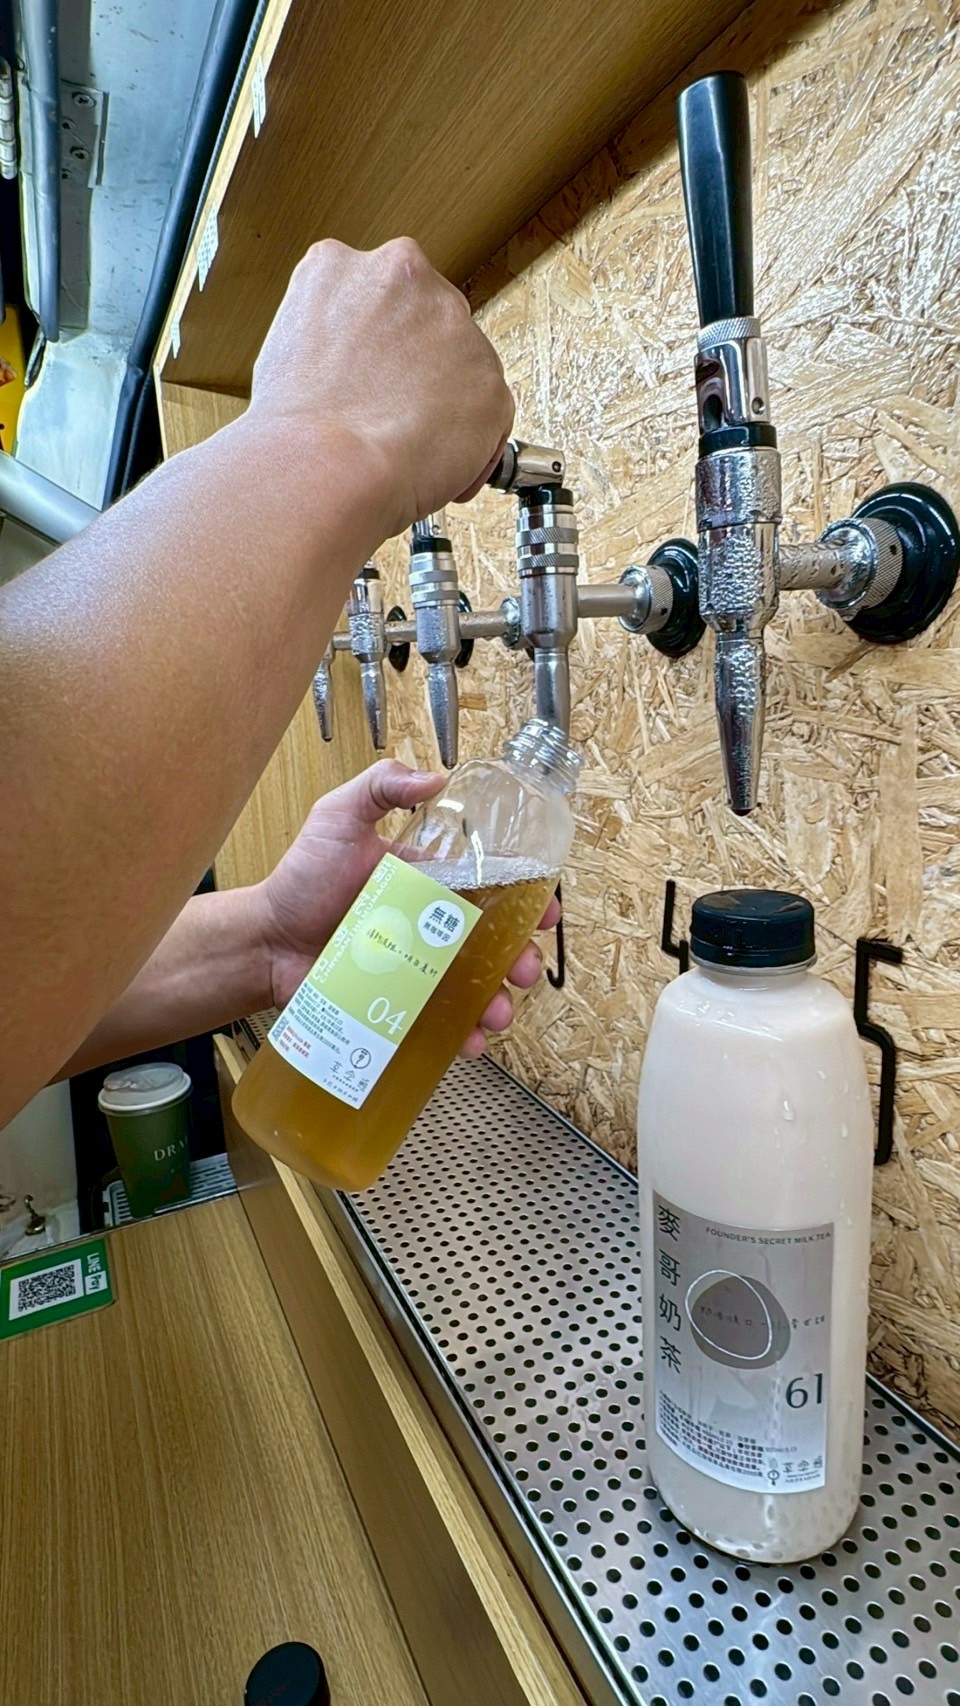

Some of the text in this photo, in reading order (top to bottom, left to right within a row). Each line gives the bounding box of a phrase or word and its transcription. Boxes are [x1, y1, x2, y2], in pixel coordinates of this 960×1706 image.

[423, 921, 451, 943] 無咖啡因
[429, 906, 460, 933] 無糖
[367, 997, 407, 1035] 04
[706, 1226, 831, 1246] FOUNDER'S SECRET MILK TEA
[87, 1252, 101, 1274] LINE
[658, 1204, 682, 1375] 麥哥奶茶
[785, 1373, 824, 1409] 61
